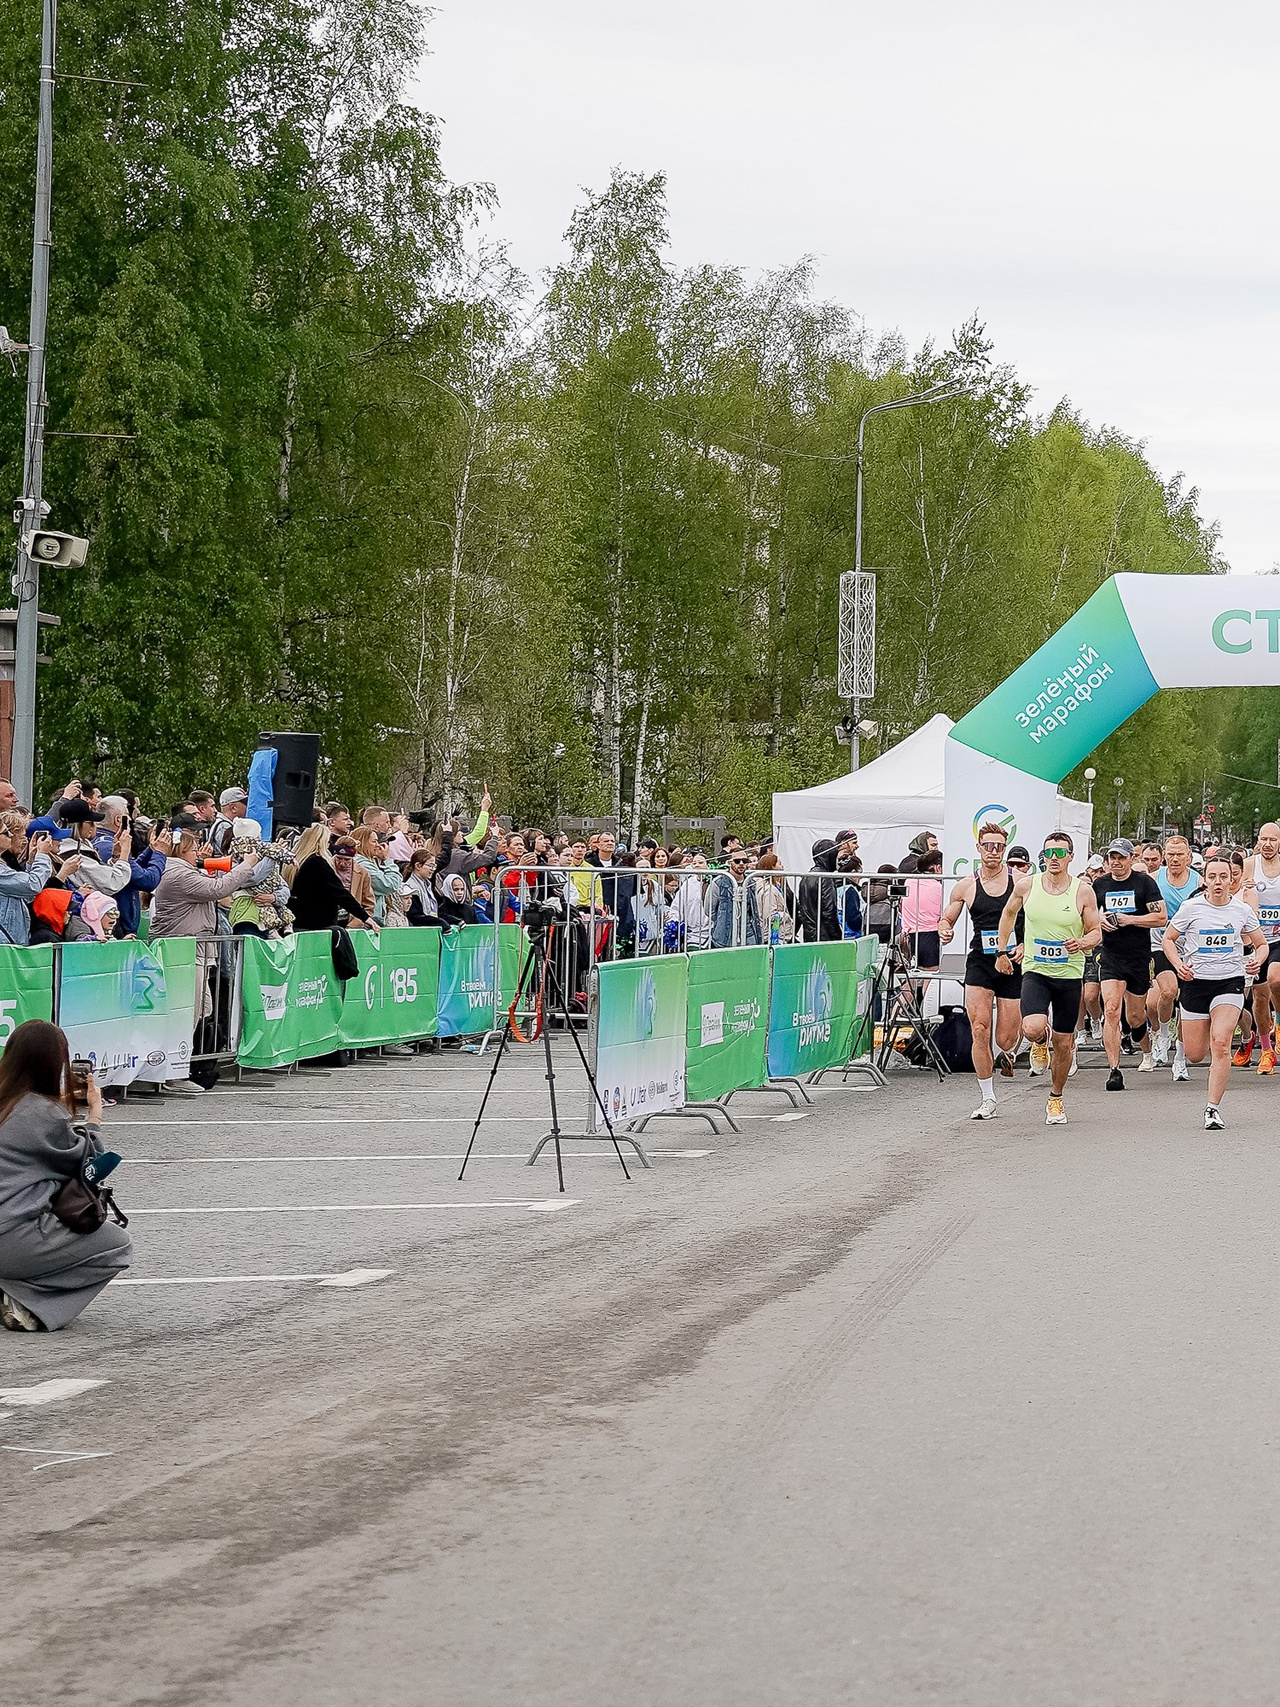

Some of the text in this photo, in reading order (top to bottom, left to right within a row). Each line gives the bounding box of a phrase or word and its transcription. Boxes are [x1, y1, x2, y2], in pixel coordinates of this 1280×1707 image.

[1015, 643, 1100, 728] зелёный
[1028, 662, 1115, 744] марафон
[1111, 897, 1128, 907] 767
[1261, 910, 1279, 919] 890
[1205, 935, 1228, 946] 848
[1040, 946, 1062, 957] 803
[389, 967, 418, 1004] 185
[798, 1023, 831, 1053] ритме
